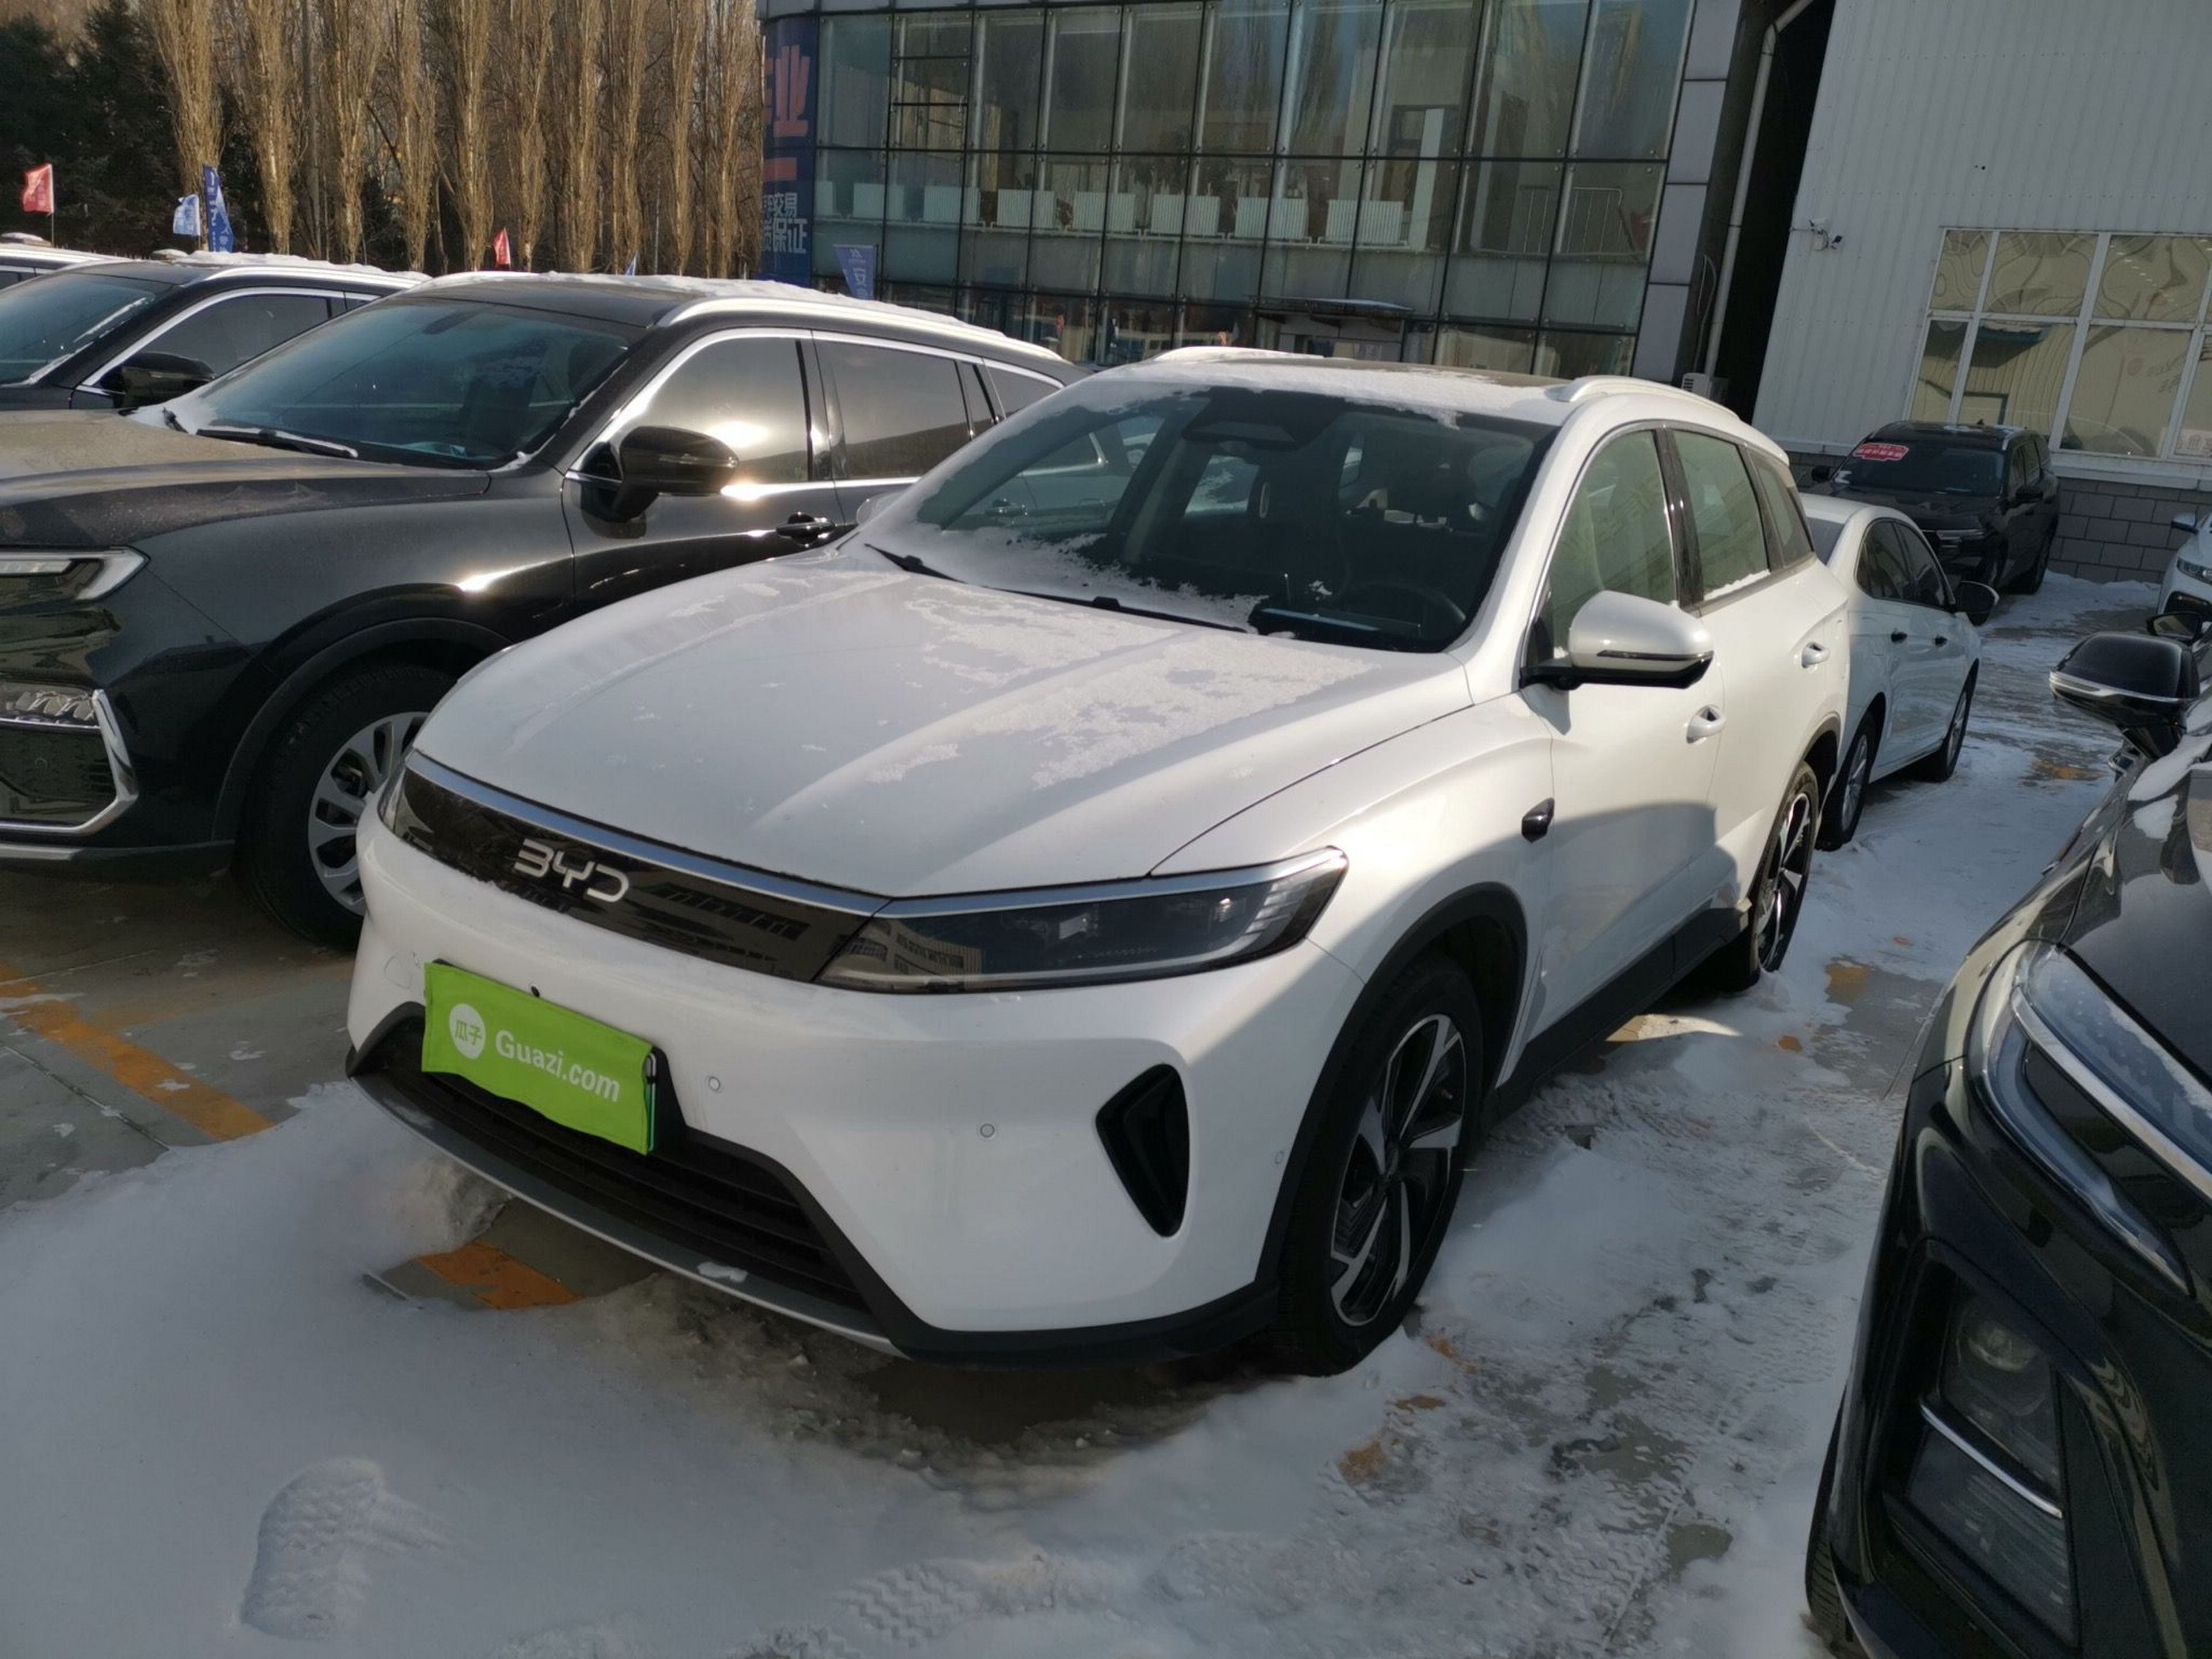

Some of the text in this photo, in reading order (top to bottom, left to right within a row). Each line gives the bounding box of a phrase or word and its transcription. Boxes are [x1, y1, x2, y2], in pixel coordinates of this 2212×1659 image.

[514, 838, 629, 903] BYD
[454, 1020, 482, 1046] 瓜子
[496, 1029, 620, 1101] Guazi.com
